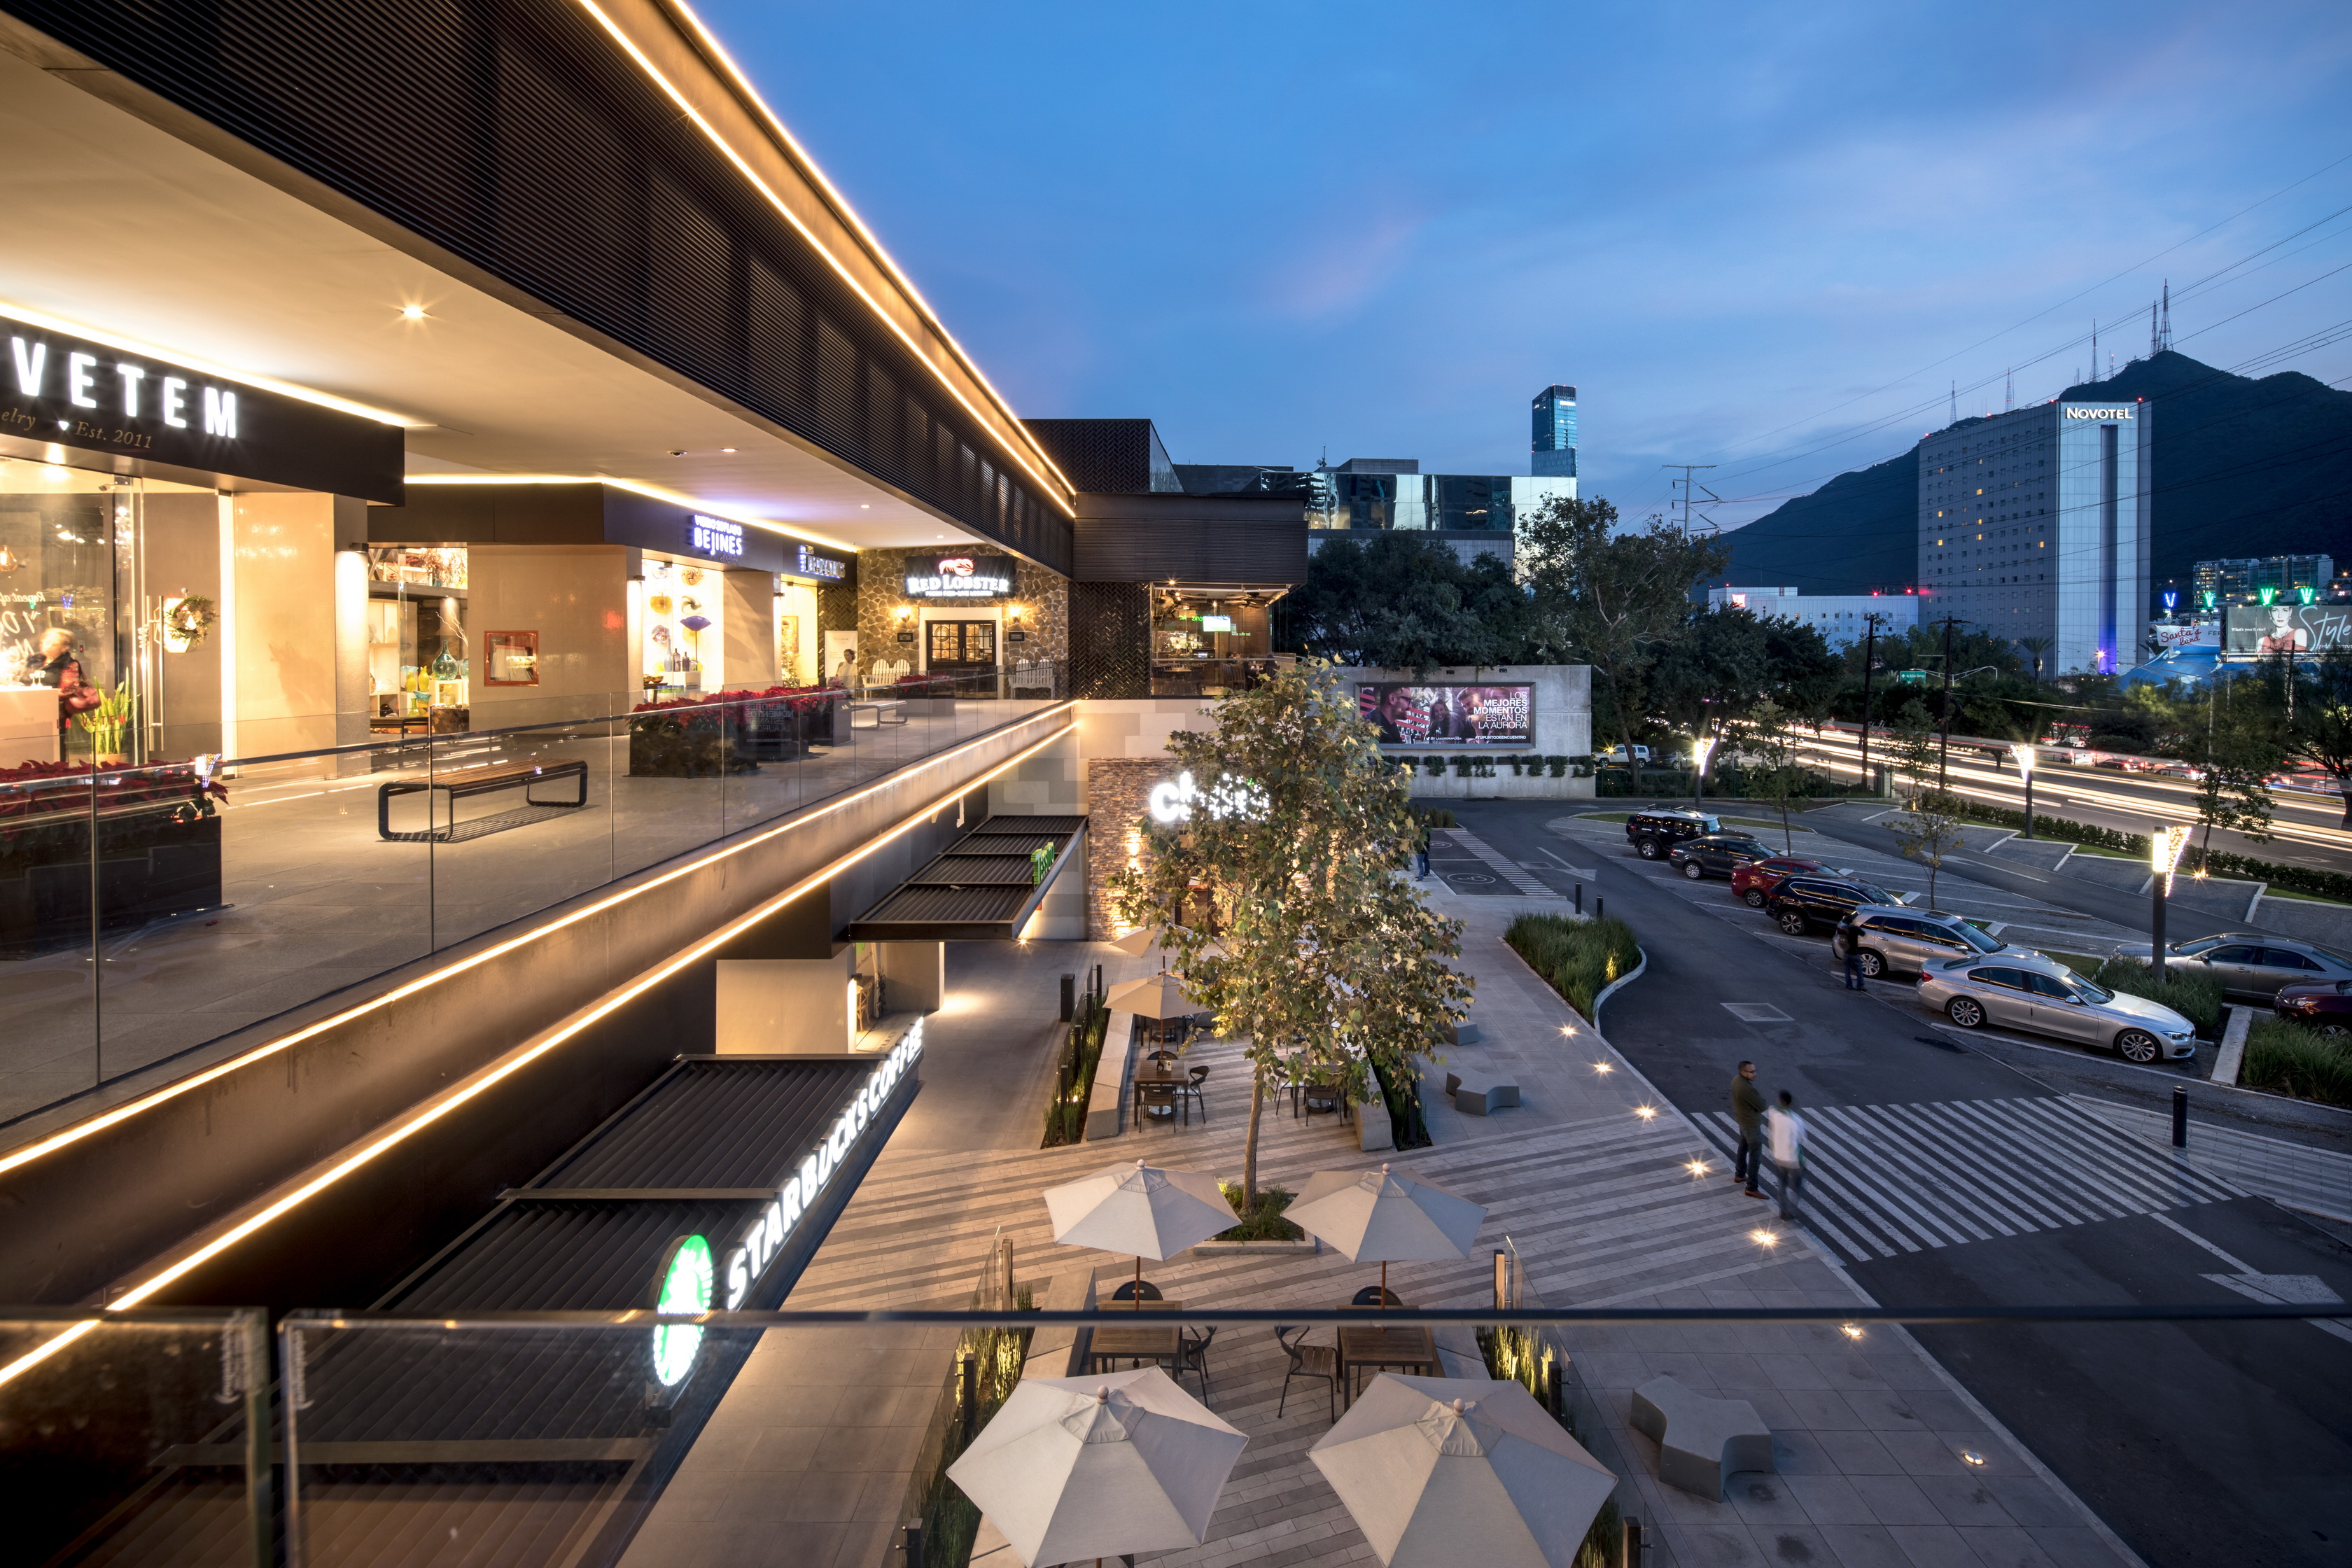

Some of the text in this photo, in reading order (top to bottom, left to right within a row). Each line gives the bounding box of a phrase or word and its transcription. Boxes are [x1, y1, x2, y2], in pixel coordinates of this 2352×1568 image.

[11, 336, 237, 439] VETEM
[2066, 407, 2133, 419] NOVOTEL
[75, 421, 107, 440] Est.
[113, 429, 152, 449] 2011
[694, 527, 742, 555] BEJINES
[907, 575, 1009, 594] RED LOBSTER
[2160, 626, 2202, 643] Santa's
[2299, 606, 2352, 651] Style
[82, 715, 126, 727] VETEM
[727, 1016, 923, 1311] STARBUCKS COFFEE
